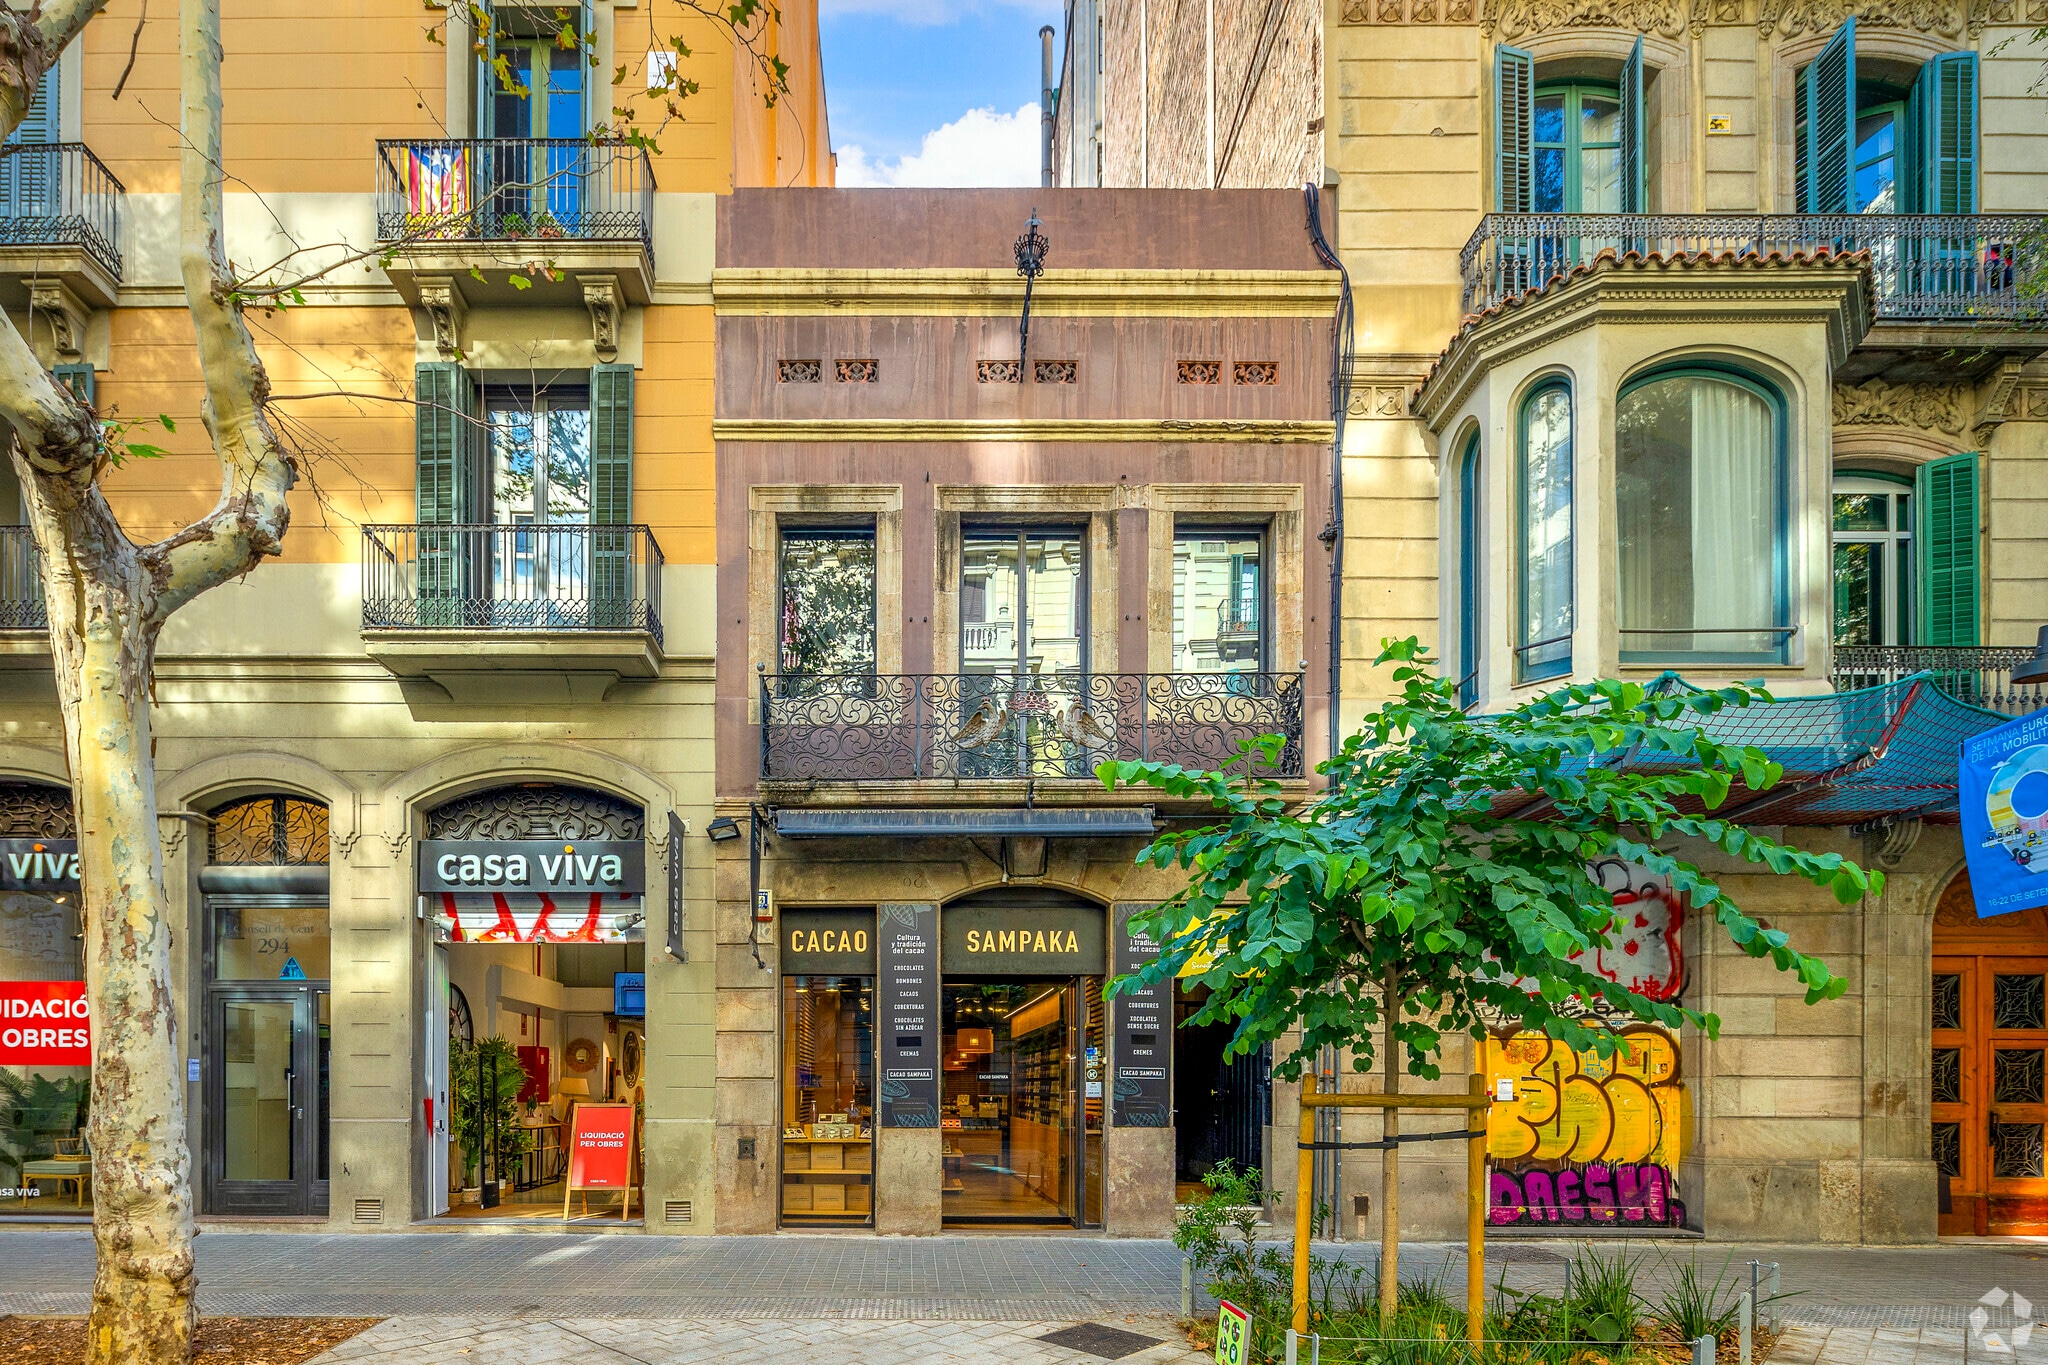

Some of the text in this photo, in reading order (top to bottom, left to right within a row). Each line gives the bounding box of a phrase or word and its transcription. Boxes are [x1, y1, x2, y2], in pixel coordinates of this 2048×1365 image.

[1971, 727, 2019, 753] SETMANA
[1971, 726, 2048, 763] DE LA MOBILIT
[437, 845, 623, 882] casa viva
[2010, 893, 2022, 902] DE
[234, 925, 271, 934] Consell
[291, 925, 315, 934] Cent
[257, 937, 290, 955] 294
[791, 930, 868, 953] CACAO
[966, 929, 1080, 953] SAMPAKA
[0, 994, 89, 1019] IDACIÓ
[2, 1028, 89, 1048] OBRES
[580, 1131, 625, 1139] LIQUIDACIÓ
[16, 1184, 40, 1197] viva
